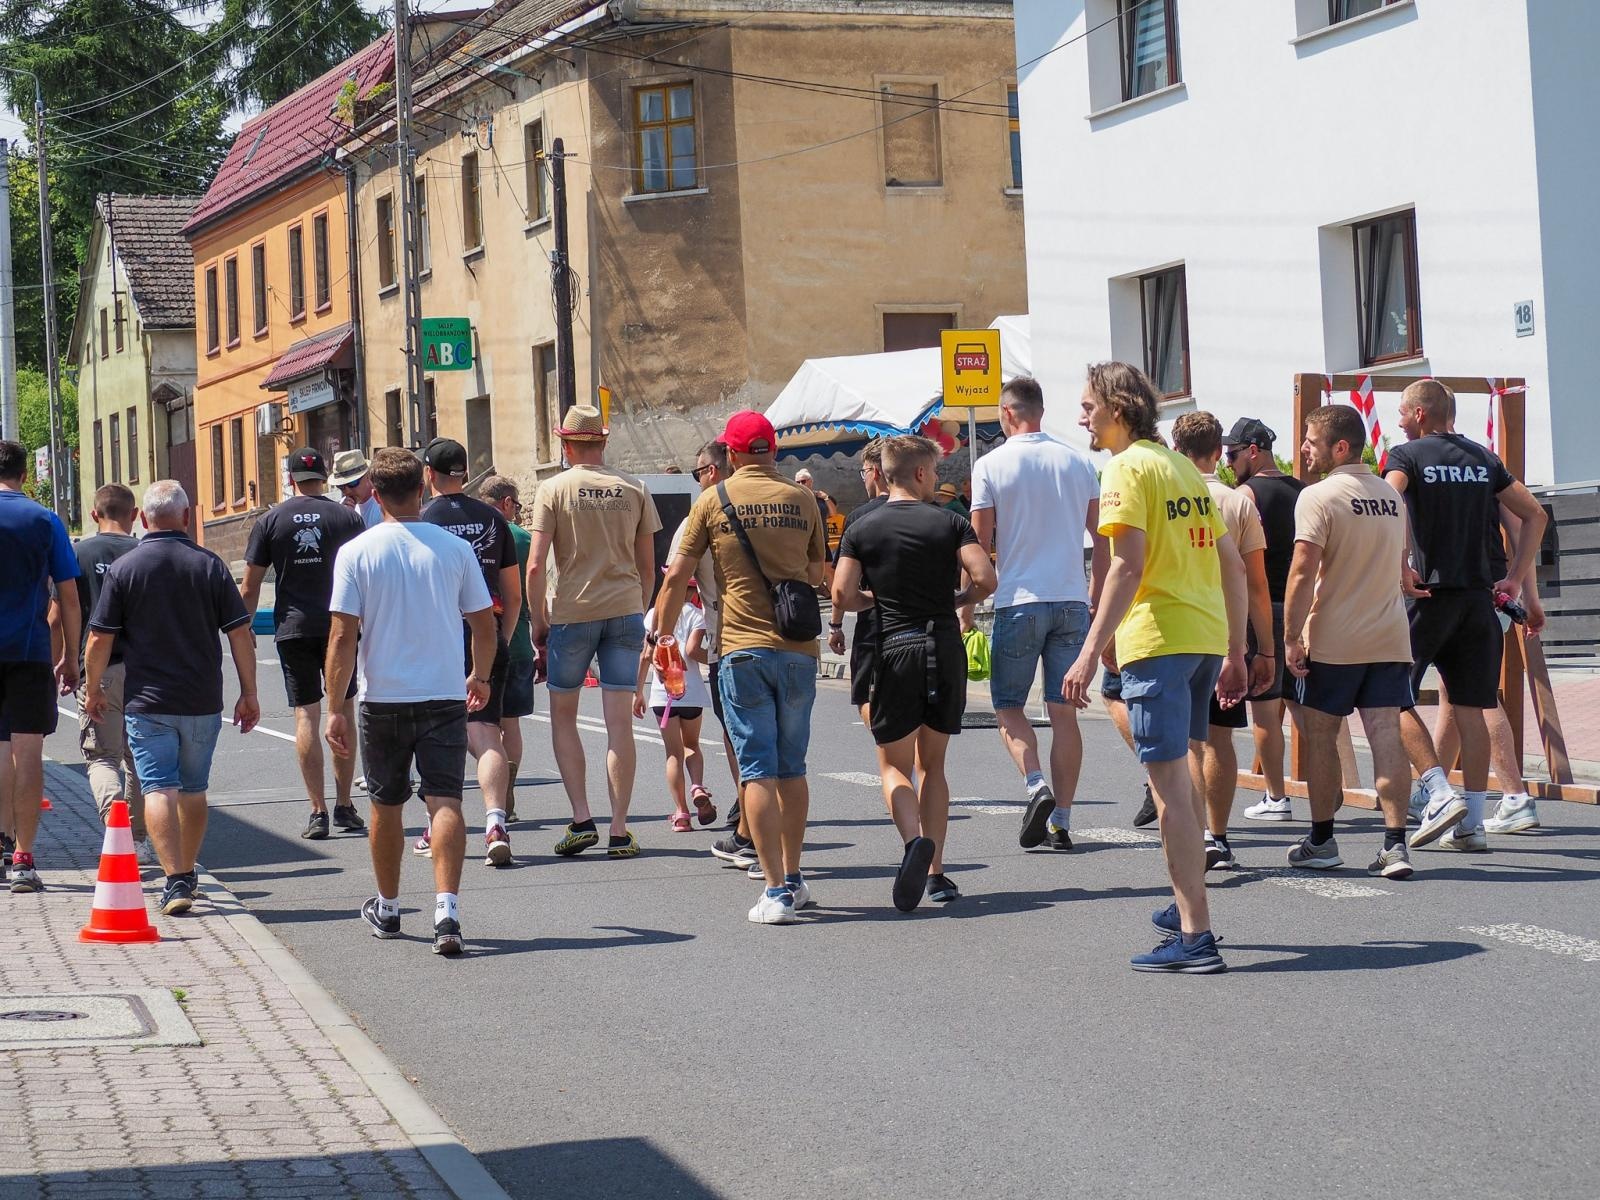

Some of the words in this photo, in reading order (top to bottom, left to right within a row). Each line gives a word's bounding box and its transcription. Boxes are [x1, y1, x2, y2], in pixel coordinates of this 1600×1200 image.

[1516, 304, 1531, 324] 18
[426, 342, 469, 366] ABC
[957, 355, 986, 366] STRAŻ
[956, 385, 989, 396] Wyjazd
[578, 486, 623, 499] STRAŻ
[737, 503, 801, 516] CHOTNICZA
[293, 513, 321, 524] OSP
[720, 517, 758, 534] SAŻ
[763, 516, 808, 531] POŻARNA
